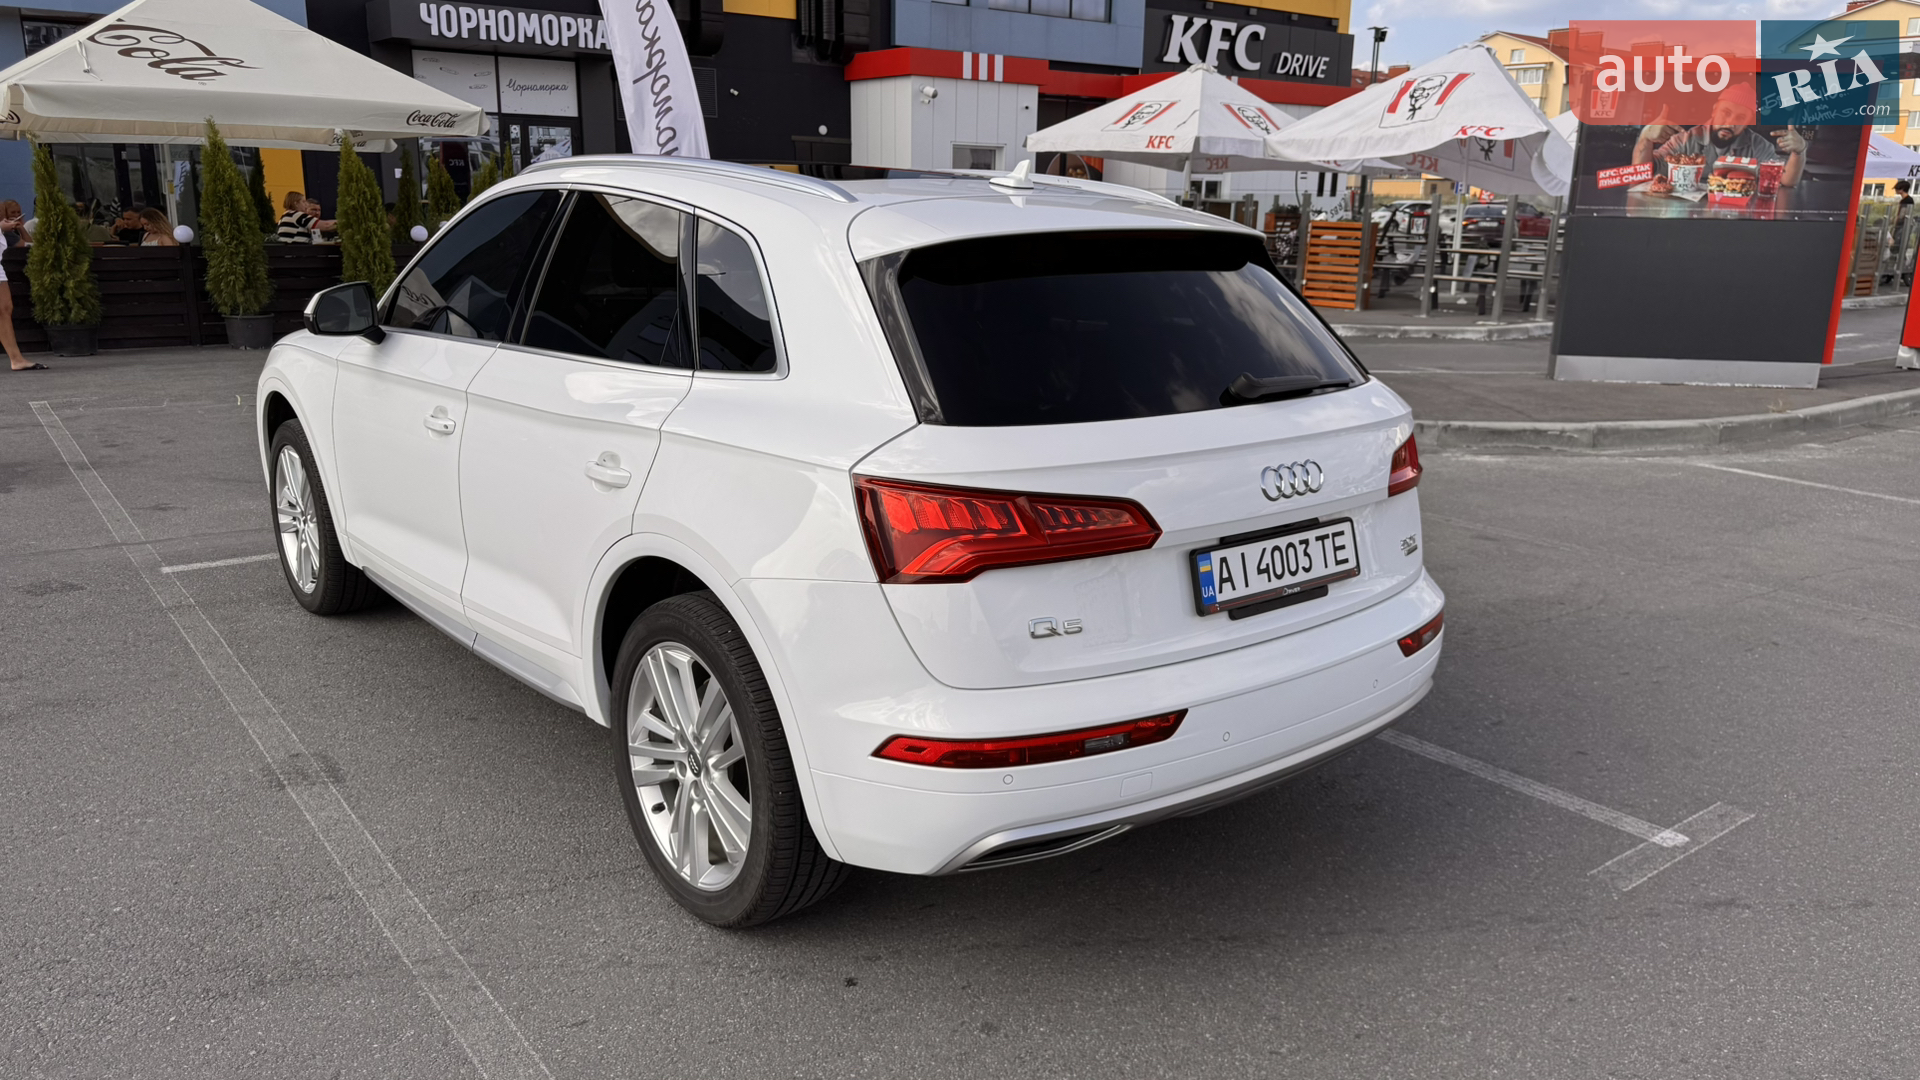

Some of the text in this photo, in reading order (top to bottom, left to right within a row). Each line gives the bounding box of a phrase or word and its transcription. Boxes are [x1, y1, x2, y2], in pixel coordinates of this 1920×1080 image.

[420, 2, 612, 50] ЧОРНОМОРКА
[1163, 14, 1330, 78] KFC DRIVE
[506, 78, 569, 96] Чорноморка
[406, 110, 459, 128] Coca-Cola
[1453, 125, 1505, 137] KFC
[1145, 136, 1175, 149] KFC
[1218, 530, 1350, 594] AI 4003 TE
[1202, 586, 1215, 598] UA
[1028, 617, 1083, 639] Q5
